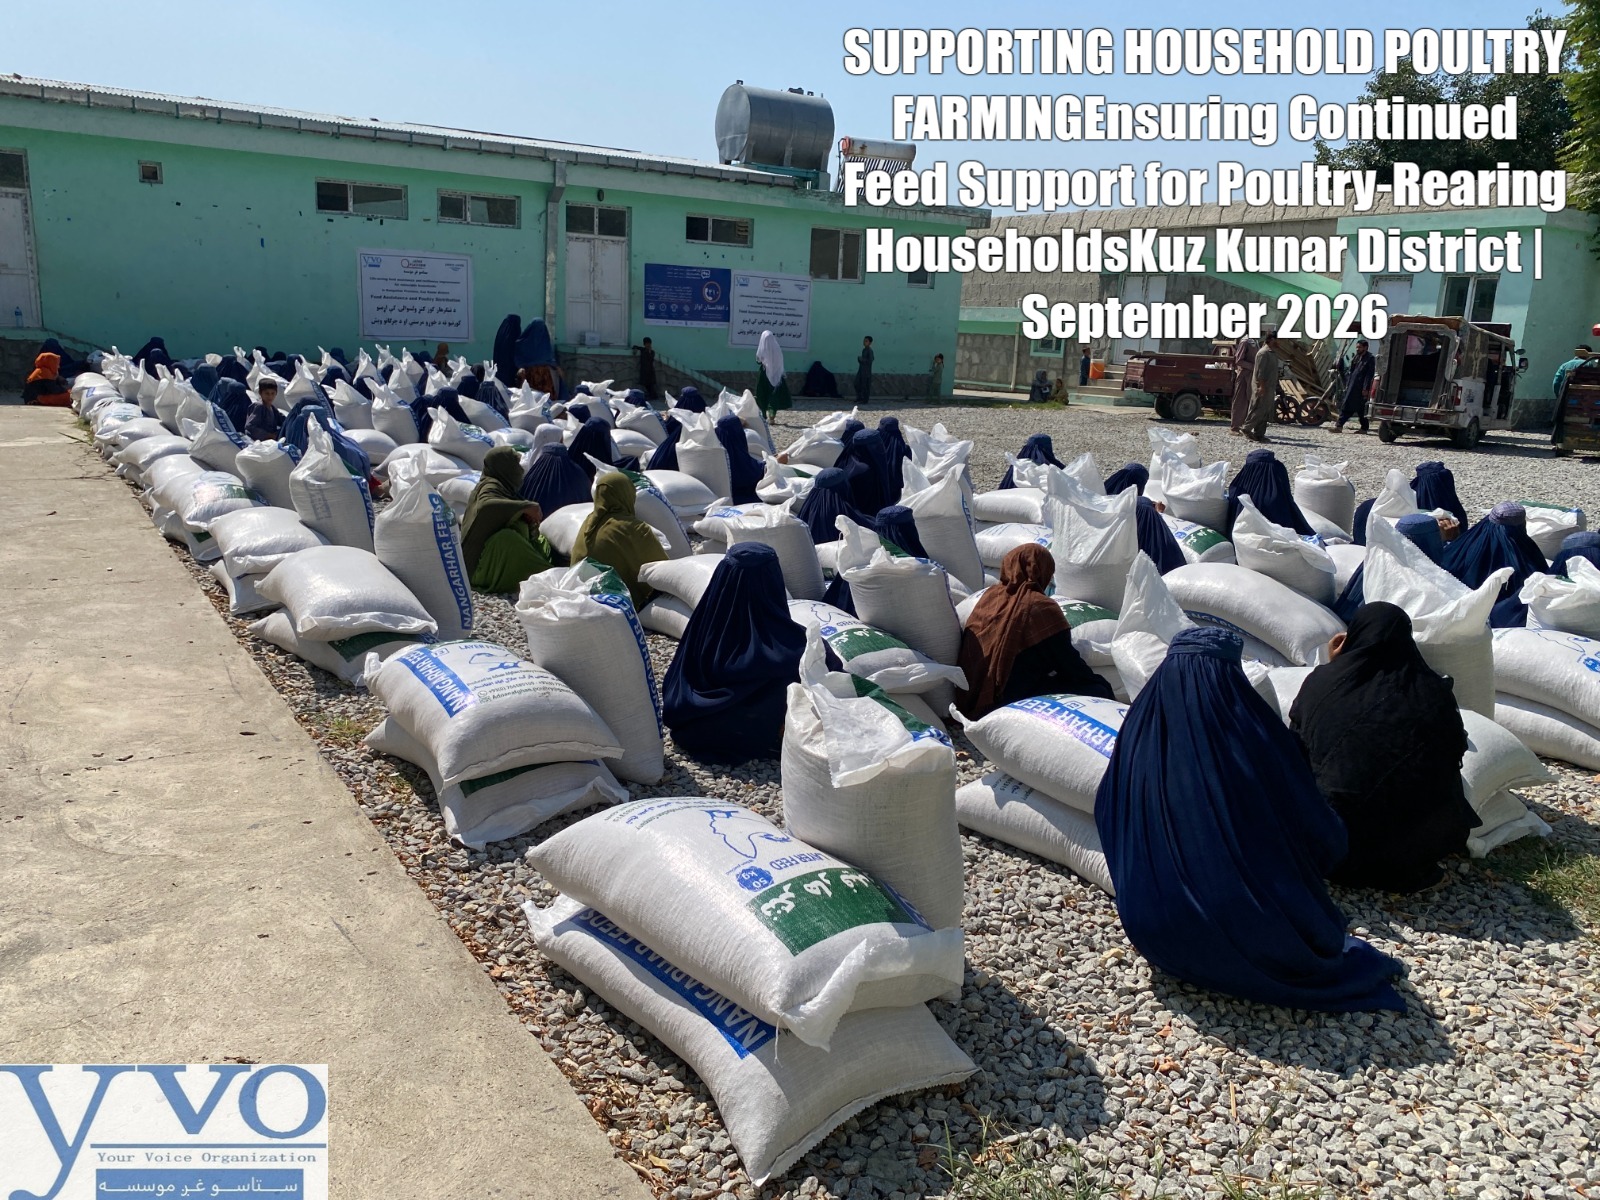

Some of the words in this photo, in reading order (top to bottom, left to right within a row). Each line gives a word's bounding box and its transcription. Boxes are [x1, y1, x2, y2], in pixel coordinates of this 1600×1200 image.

[439, 540, 473, 630] NANGARHAR
[415, 657, 466, 712] NANGARHAR
[769, 855, 799, 870] FEED
[742, 870, 759, 881] kg
[752, 877, 769, 889] 50
